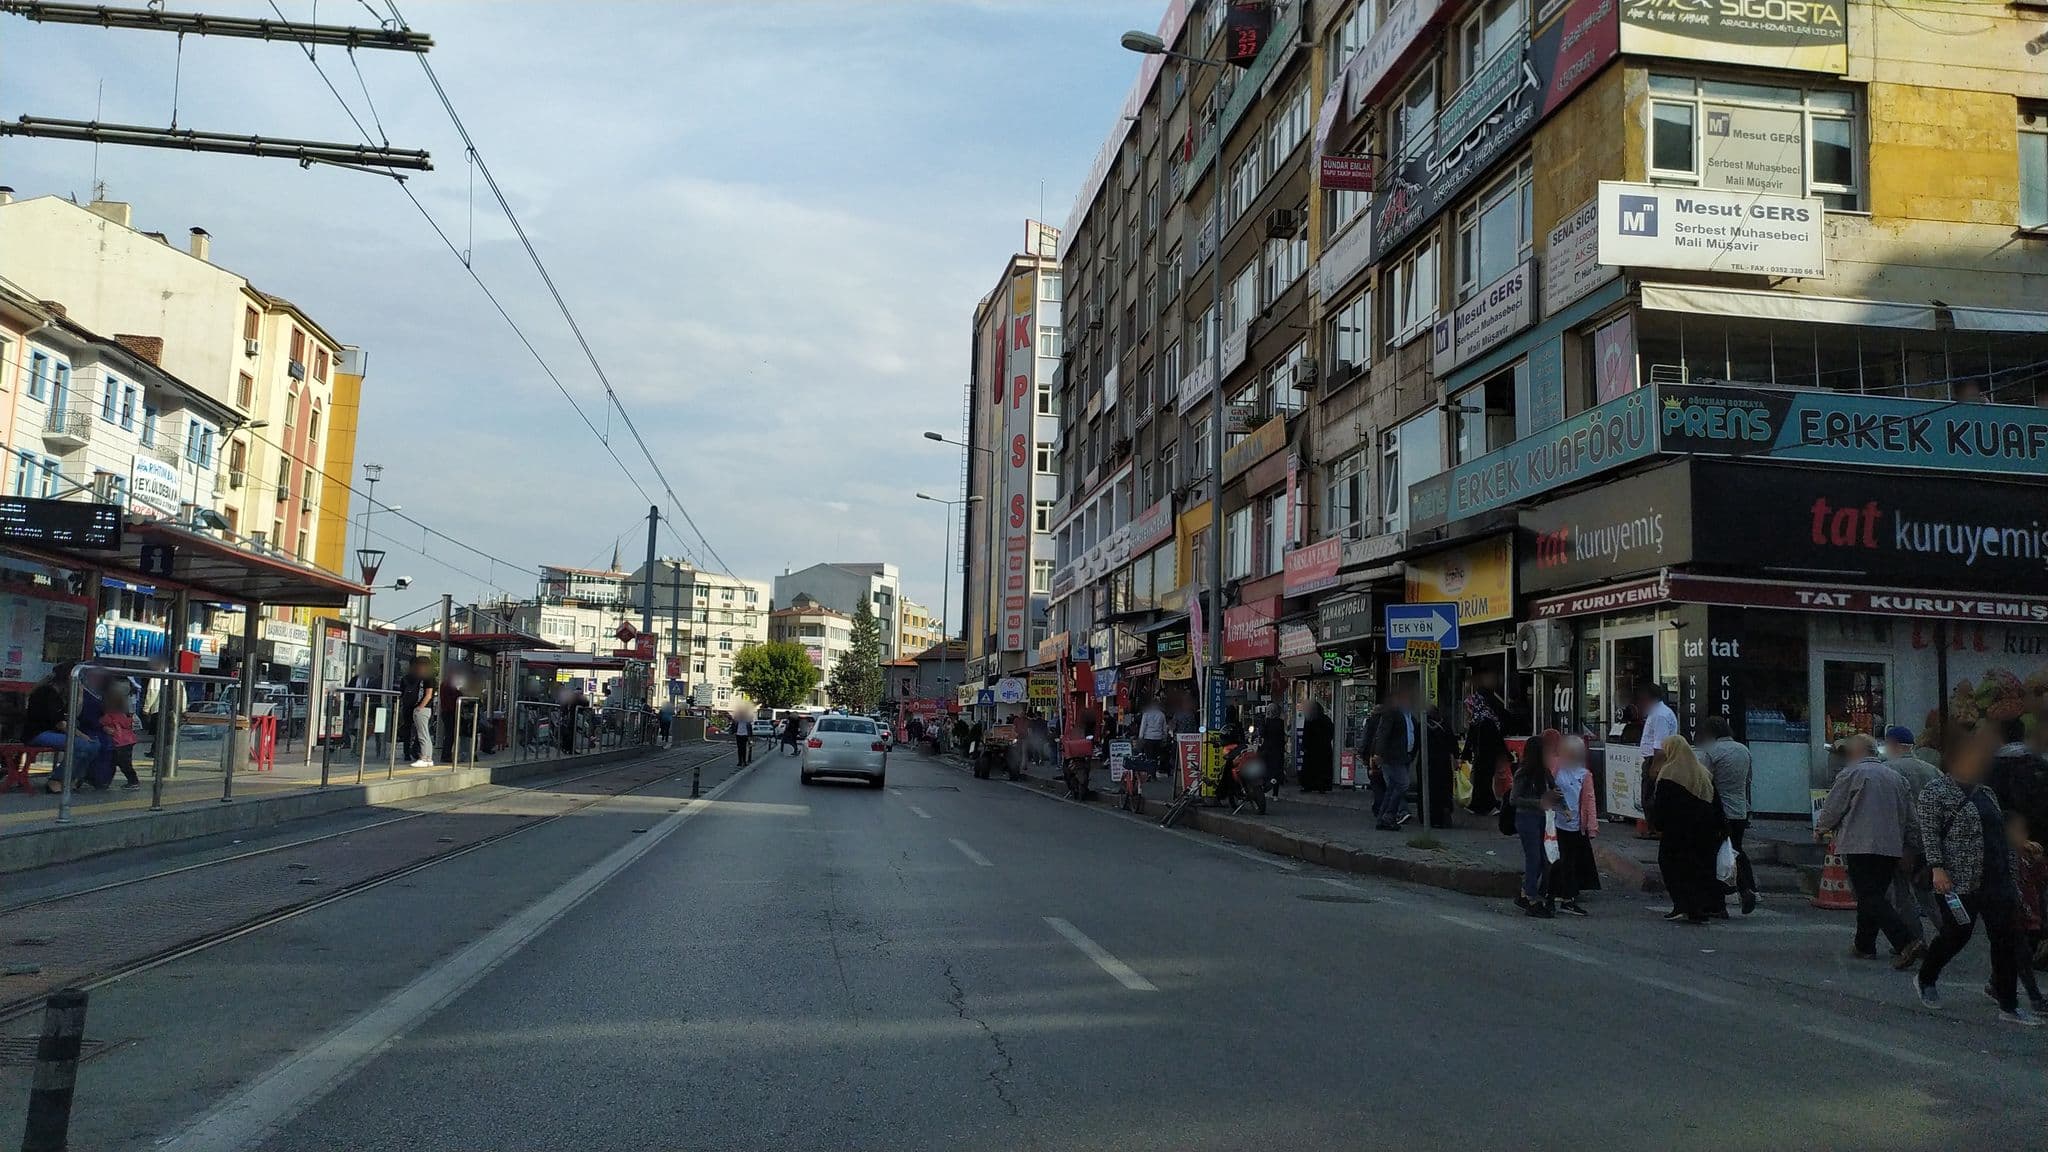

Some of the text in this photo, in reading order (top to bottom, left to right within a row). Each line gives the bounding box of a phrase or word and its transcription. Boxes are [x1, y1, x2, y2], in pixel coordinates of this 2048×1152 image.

[1733, 129, 1801, 144] Mesut GERS
[1707, 157, 1801, 175] Serbest Muhasebeci
[1726, 175, 1784, 189] Mali Müşavir
[1676, 199, 1810, 222] Mesut GERS
[1552, 222, 1574, 247] SENA
[1675, 222, 1809, 242] Serbest Muhasebeci
[1675, 237, 1759, 252] Mali Müşavir
[1456, 303, 1487, 332] Mesut
[1490, 274, 1524, 308] GERS
[1662, 404, 1772, 441] PRENS
[1799, 409, 2048, 461] ERKEK KUAF
[1457, 395, 1646, 513] ERKEK KUAFÖRÜ
[1810, 497, 1883, 549] tat
[1536, 507, 1664, 569] tat kuruyemiş
[1539, 584, 1670, 617] TAT KURUYEMİŞ
[1795, 591, 2048, 621] TAT KURUYEMİŞ
[1392, 620, 1433, 633] TEK YÖN
[1408, 648, 1439, 659] TAKSİ
[1684, 637, 1704, 657] tat
[1711, 637, 1740, 658] tat
